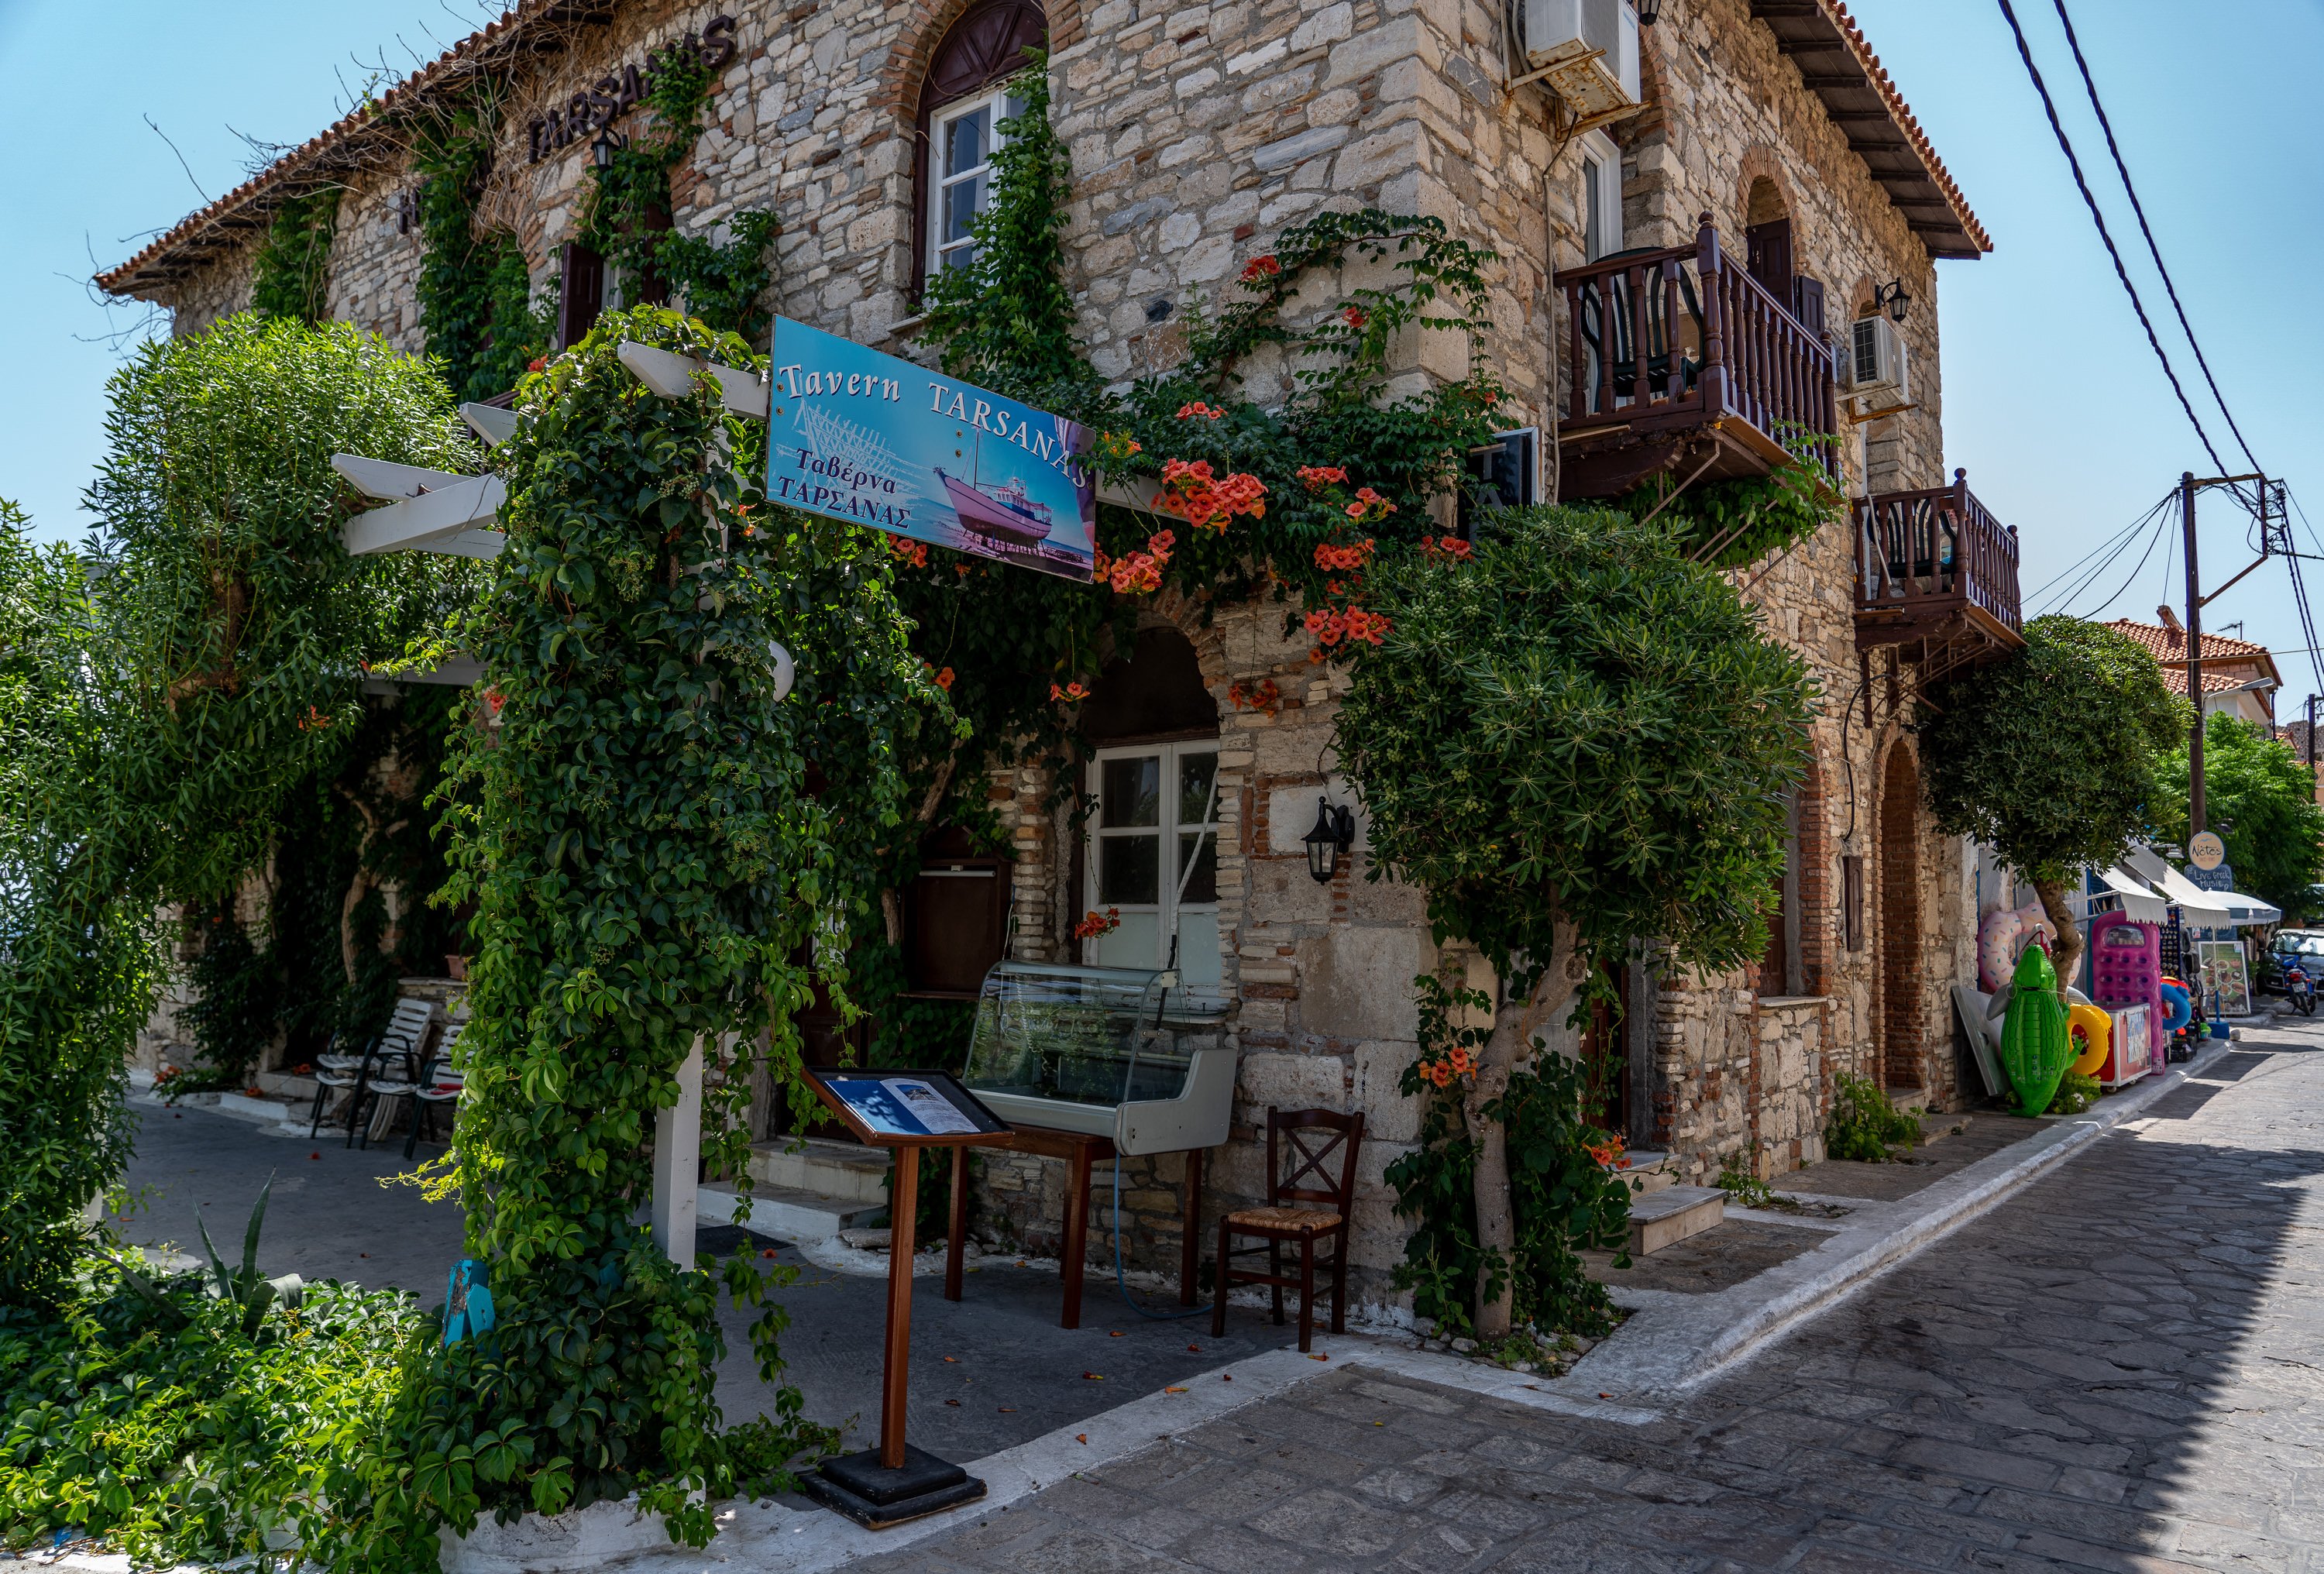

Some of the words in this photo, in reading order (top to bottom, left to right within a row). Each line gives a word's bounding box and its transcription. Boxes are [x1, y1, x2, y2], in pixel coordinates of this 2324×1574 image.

[779, 364, 900, 402] Tavern
[929, 382, 1091, 488] TARSANAS
[796, 448, 896, 493] Ταβέρνα
[778, 475, 911, 529] ΤΑΡΣΑΝΑΣ
